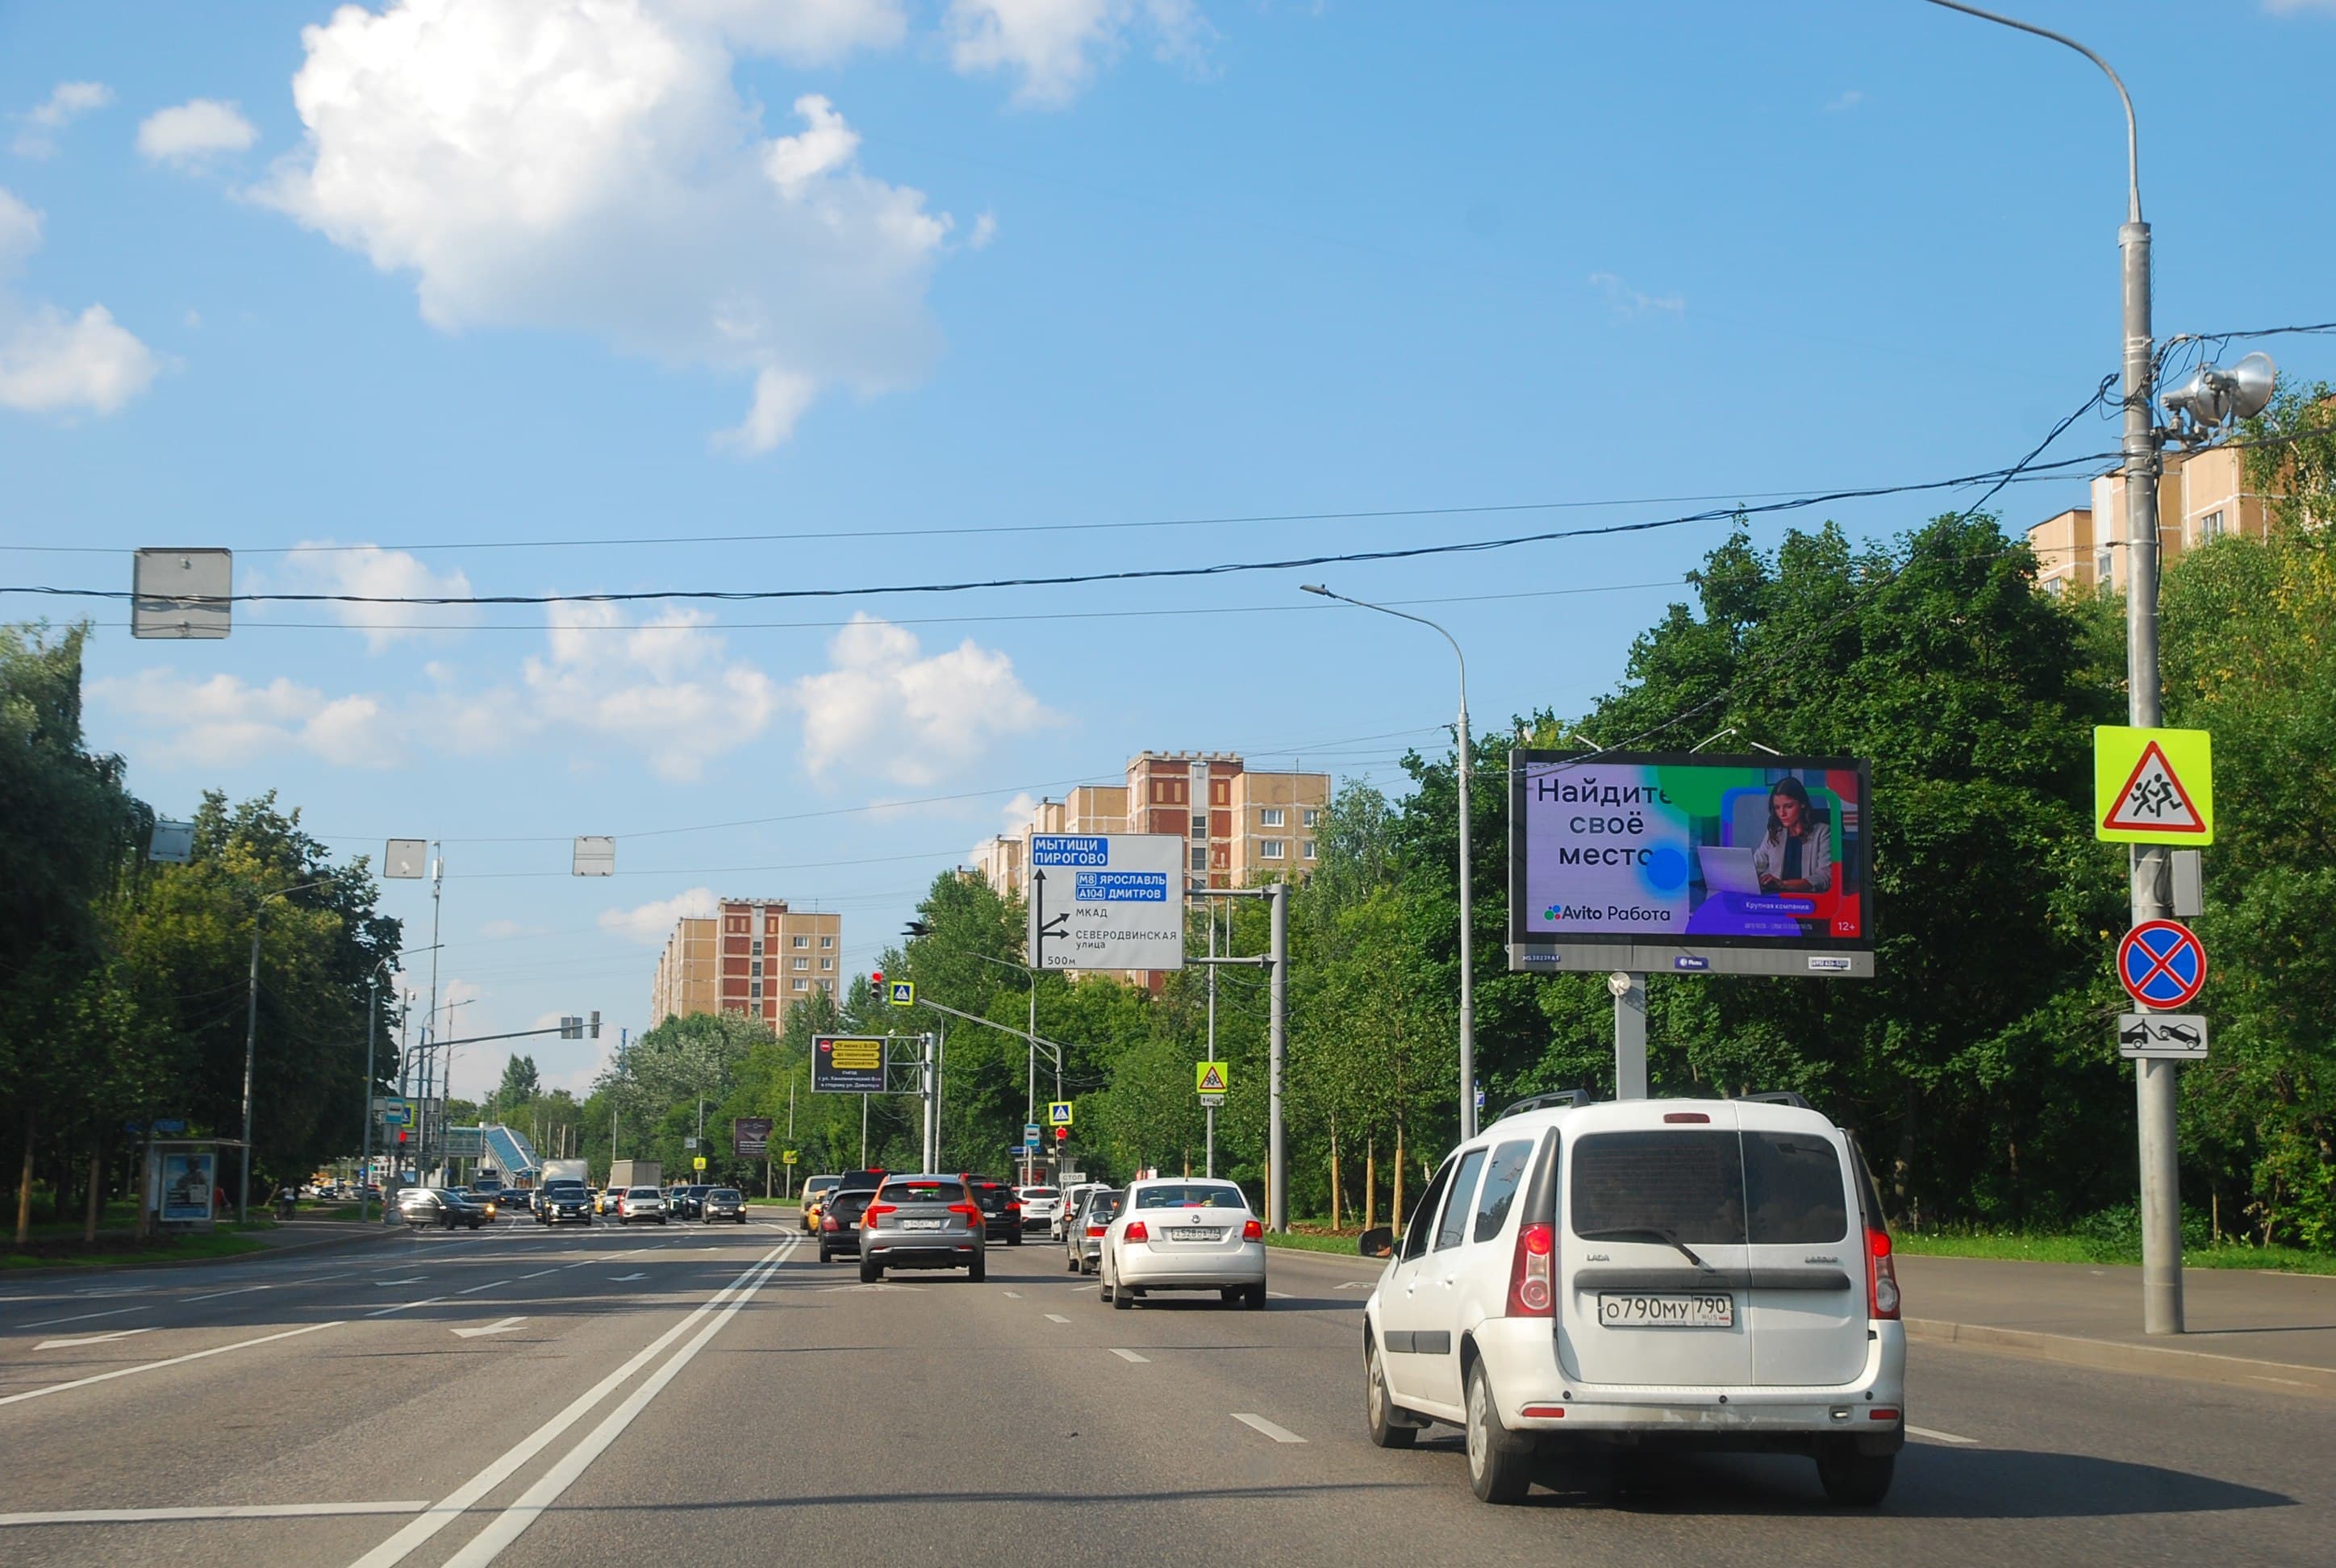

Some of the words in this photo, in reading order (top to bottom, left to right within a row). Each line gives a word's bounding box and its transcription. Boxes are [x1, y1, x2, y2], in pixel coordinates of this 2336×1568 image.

[1570, 811, 1644, 835] своё
[1035, 840, 1098, 852] МЫТИЩИ
[1035, 853, 1106, 865] ПИРОГОВО
[1079, 876, 1095, 885] М8
[1099, 876, 1166, 886] ЯРОСЛАВЛЬ
[1079, 889, 1103, 899] А104
[1108, 889, 1161, 899] ДМИТРОВ
[1746, 902, 1774, 910] Крупная
[1775, 903, 1809, 911] компания
[1076, 908, 1108, 918] МКАД
[1562, 905, 1602, 920] Avito
[1608, 906, 1671, 921] Работа
[1838, 922, 1855, 931] 12+
[1075, 930, 1177, 940] СЕВЕРОДВИНСКАЯ
[1076, 941, 1106, 950] улица
[1047, 957, 1075, 965] 500м
[1694, 1297, 1725, 1314] 790
